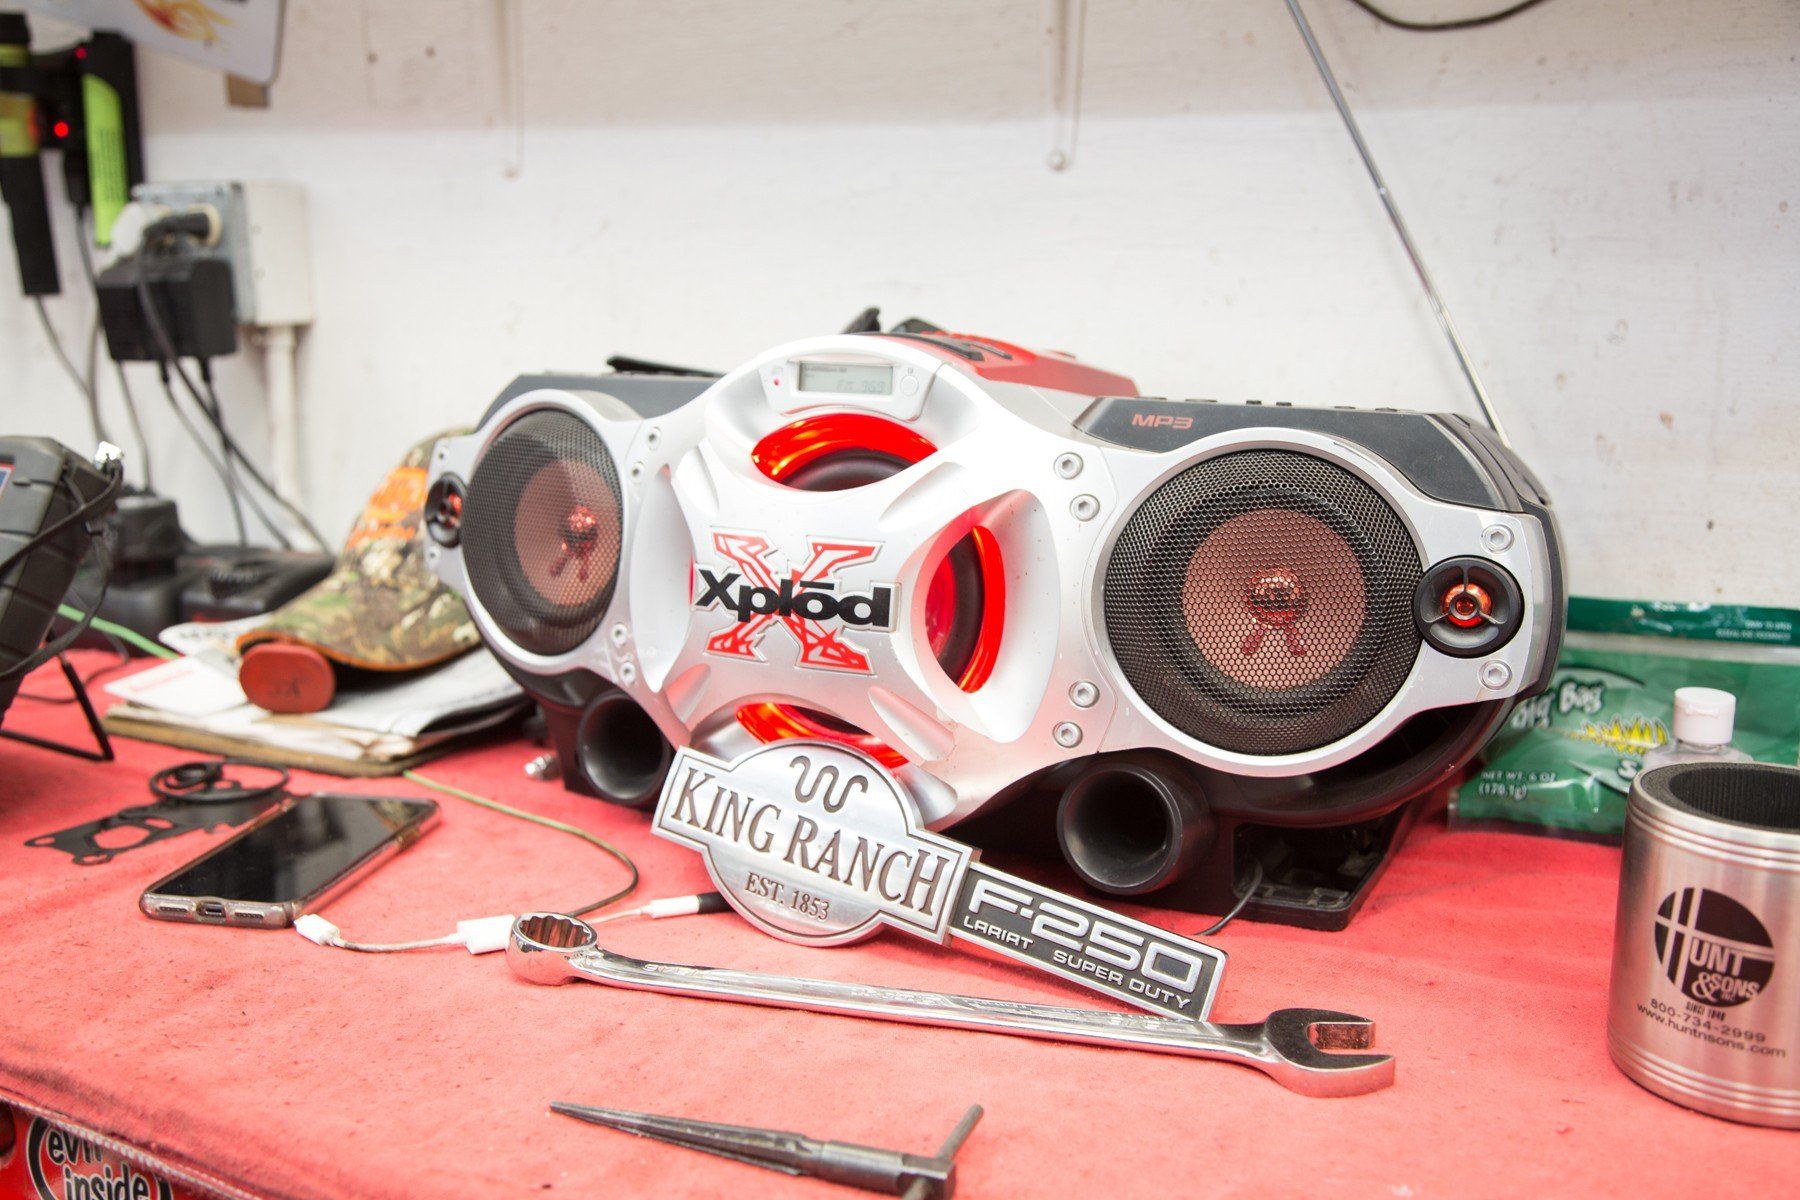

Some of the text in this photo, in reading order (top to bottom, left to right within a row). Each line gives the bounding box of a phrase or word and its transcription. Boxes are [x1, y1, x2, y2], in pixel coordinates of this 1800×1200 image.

[1131, 413, 1194, 430] MP3
[671, 767, 950, 916] KING RANCH
[745, 872, 830, 921] EST. 1853
[969, 879, 1203, 993] F-250
[963, 915, 1192, 1010] LARIAT SUPER DUTY
[1691, 971, 1760, 1003] & SONS
[1637, 1003, 1786, 1058] www.huntnsons.com
[1651, 998, 1766, 1042] 800-734-2999
[64, 1163, 149, 1200] inside
